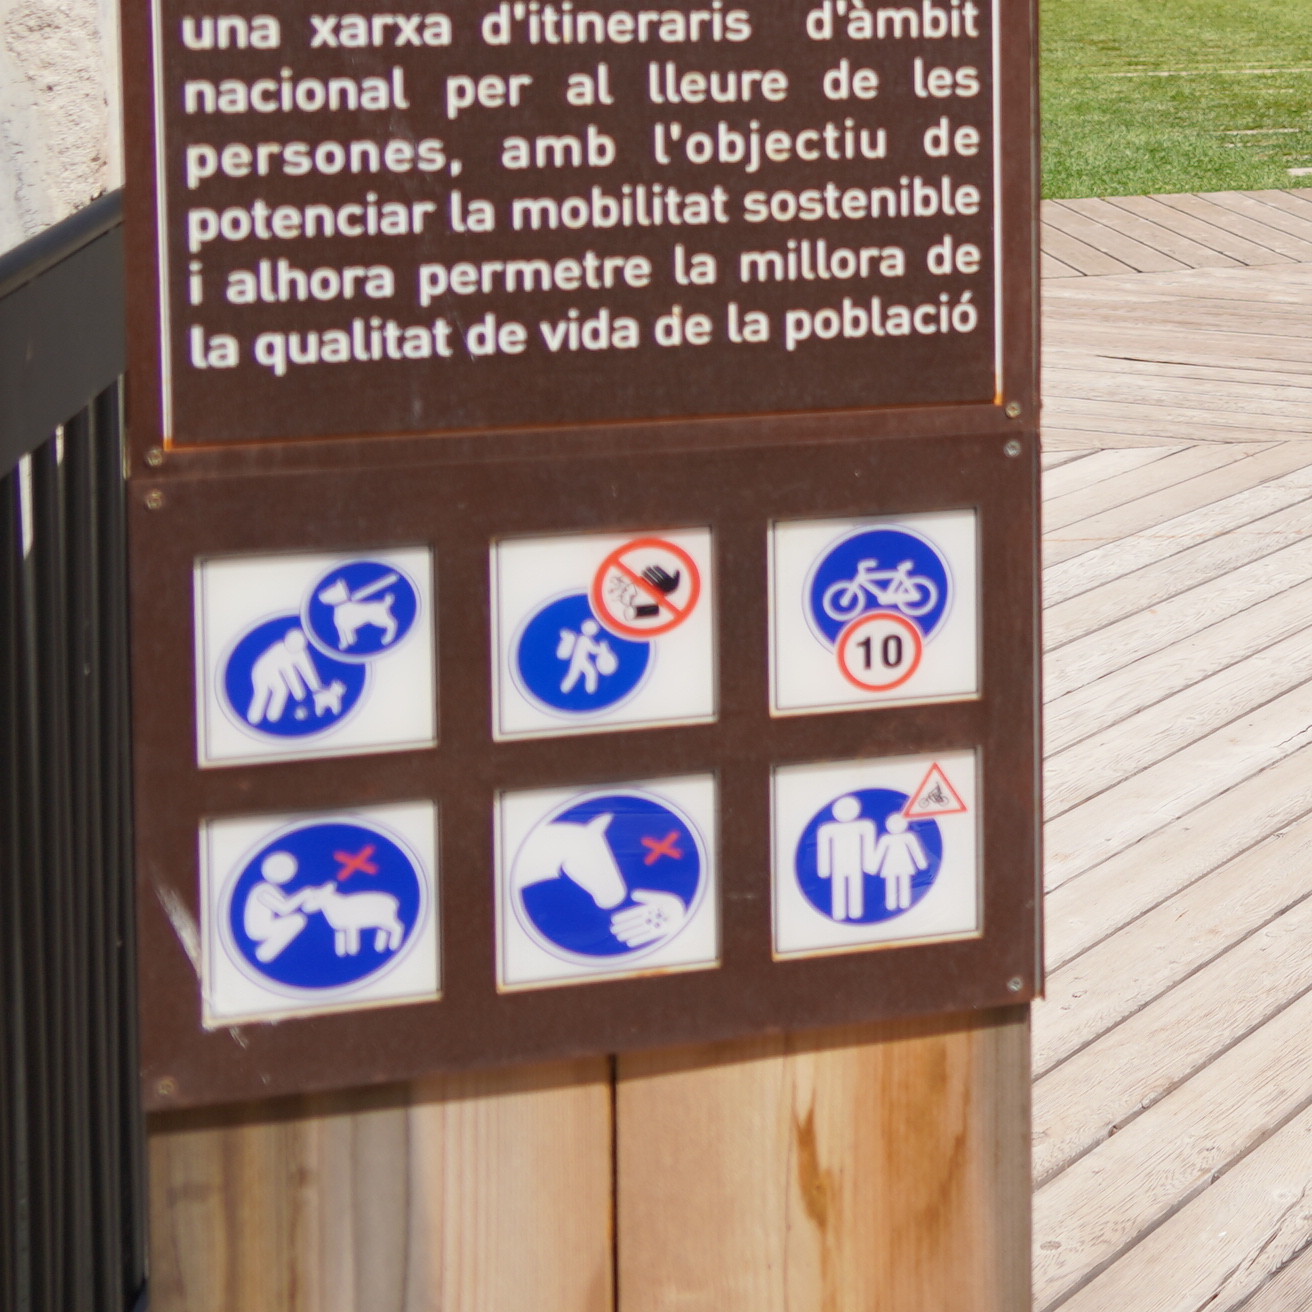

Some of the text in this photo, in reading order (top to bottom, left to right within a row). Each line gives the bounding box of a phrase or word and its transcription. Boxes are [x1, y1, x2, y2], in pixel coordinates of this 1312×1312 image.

[183, 16, 279, 49] una
[311, 14, 451, 47] xarxa
[482, 0, 751, 44] d'itineraris
[185, 58, 979, 119] nacional per al lleure de les
[187, 117, 979, 188] persones, amb l'objectiu de
[189, 176, 979, 252] potenciar la mobilitat sostenible
[190, 235, 980, 306] i alhora permetre la millora de
[191, 291, 977, 375] la qualitat de vida de la població
[856, 634, 903, 670] 10
